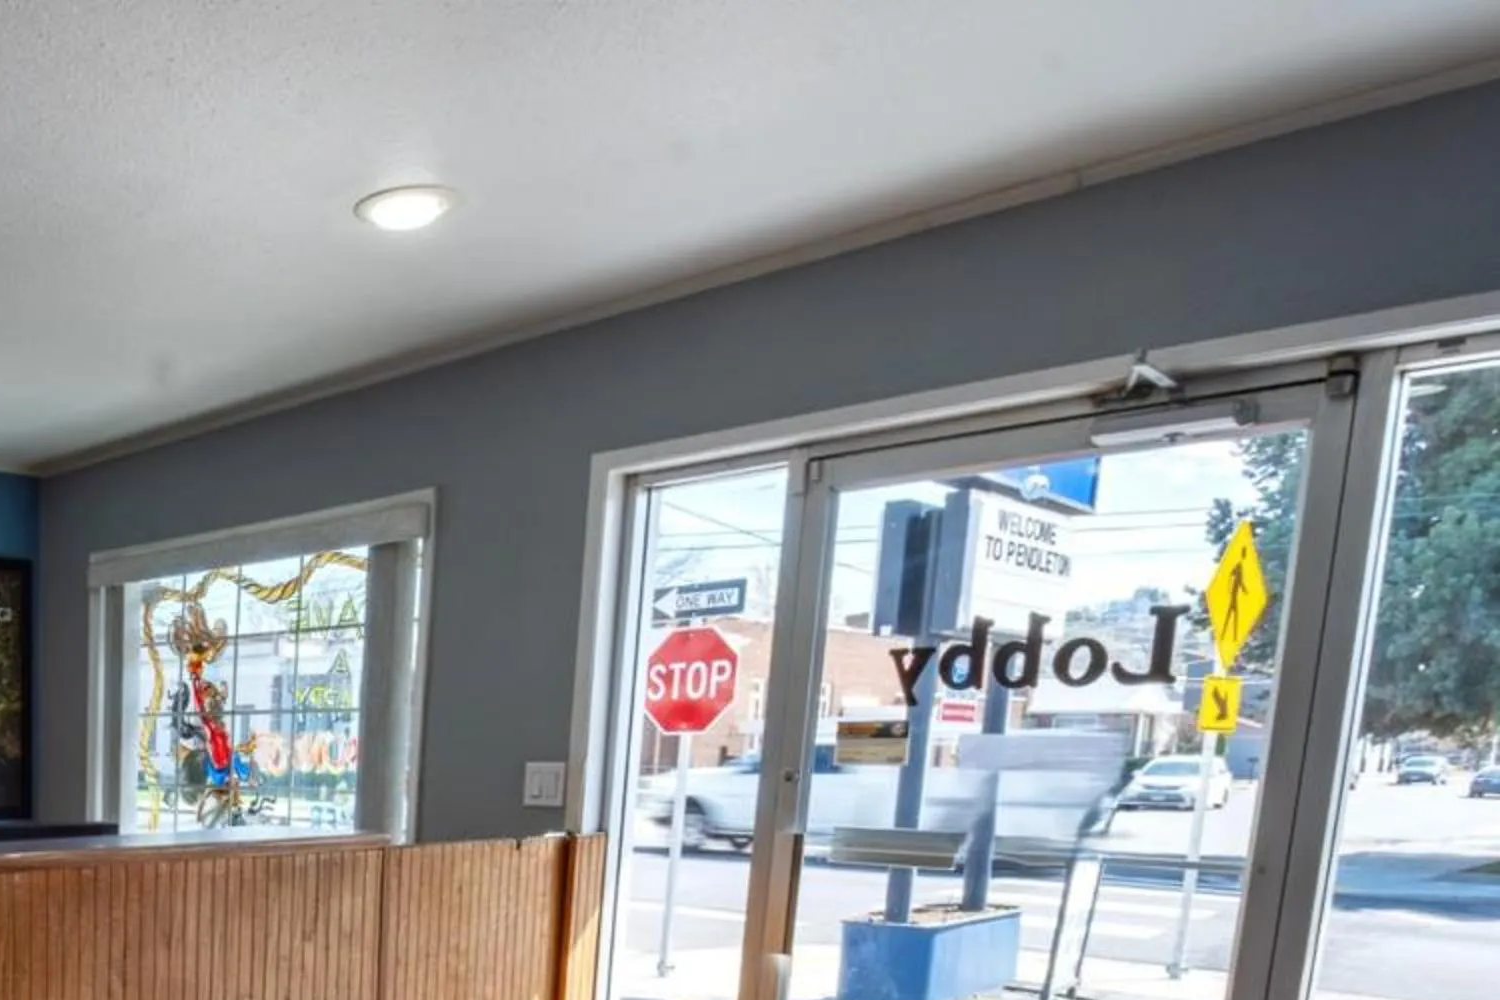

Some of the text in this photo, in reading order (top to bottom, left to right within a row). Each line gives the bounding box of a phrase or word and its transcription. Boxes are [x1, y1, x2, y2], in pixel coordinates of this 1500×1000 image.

[997, 509, 1058, 546] WELCOME
[985, 535, 1072, 578] TO PENDLETON
[675, 589, 736, 609] ONE WAY
[647, 659, 733, 702] STOP
